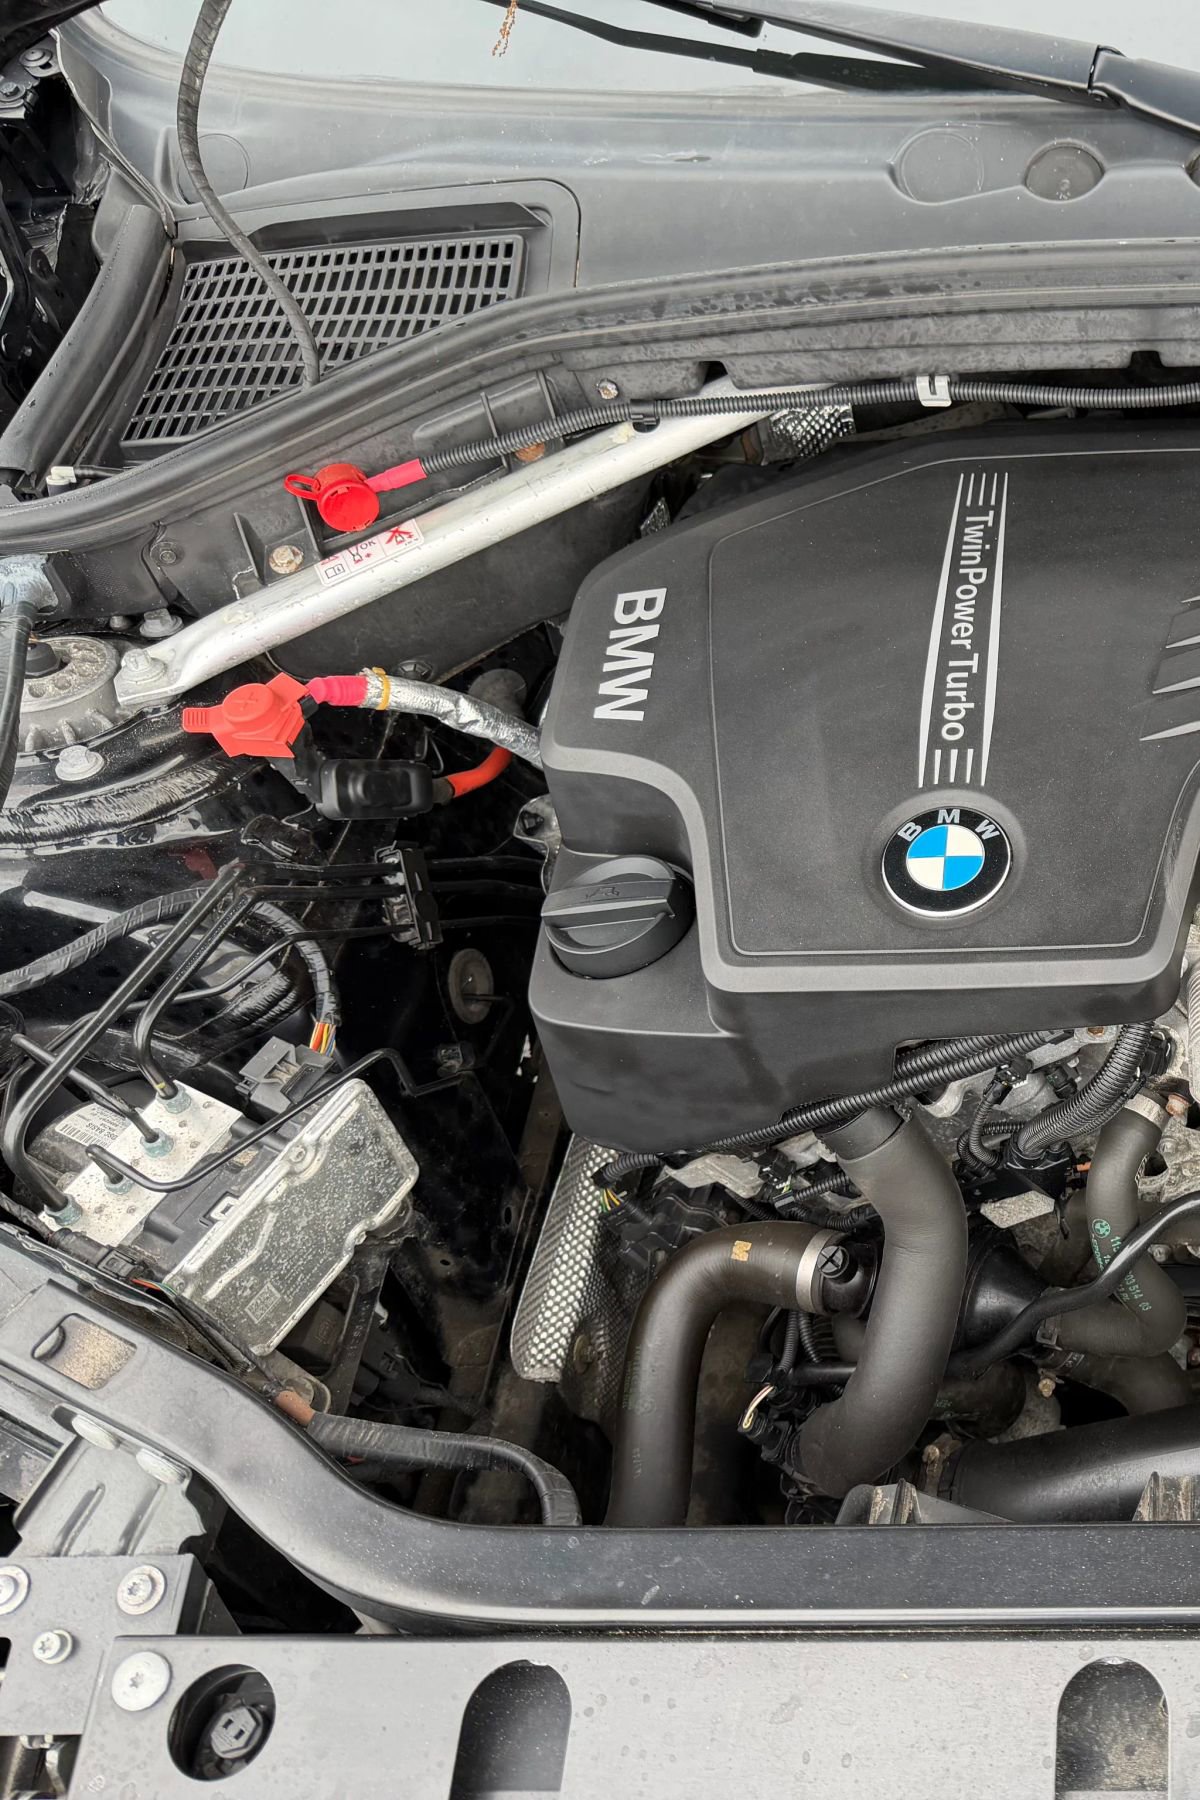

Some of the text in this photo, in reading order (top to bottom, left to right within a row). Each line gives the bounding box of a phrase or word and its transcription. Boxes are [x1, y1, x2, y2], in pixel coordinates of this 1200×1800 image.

[360, 540, 376, 550] OK
[593, 587, 667, 721] BMW
[941, 510, 994, 741] TwinPower Turbo
[897, 809, 1001, 842] BMW
